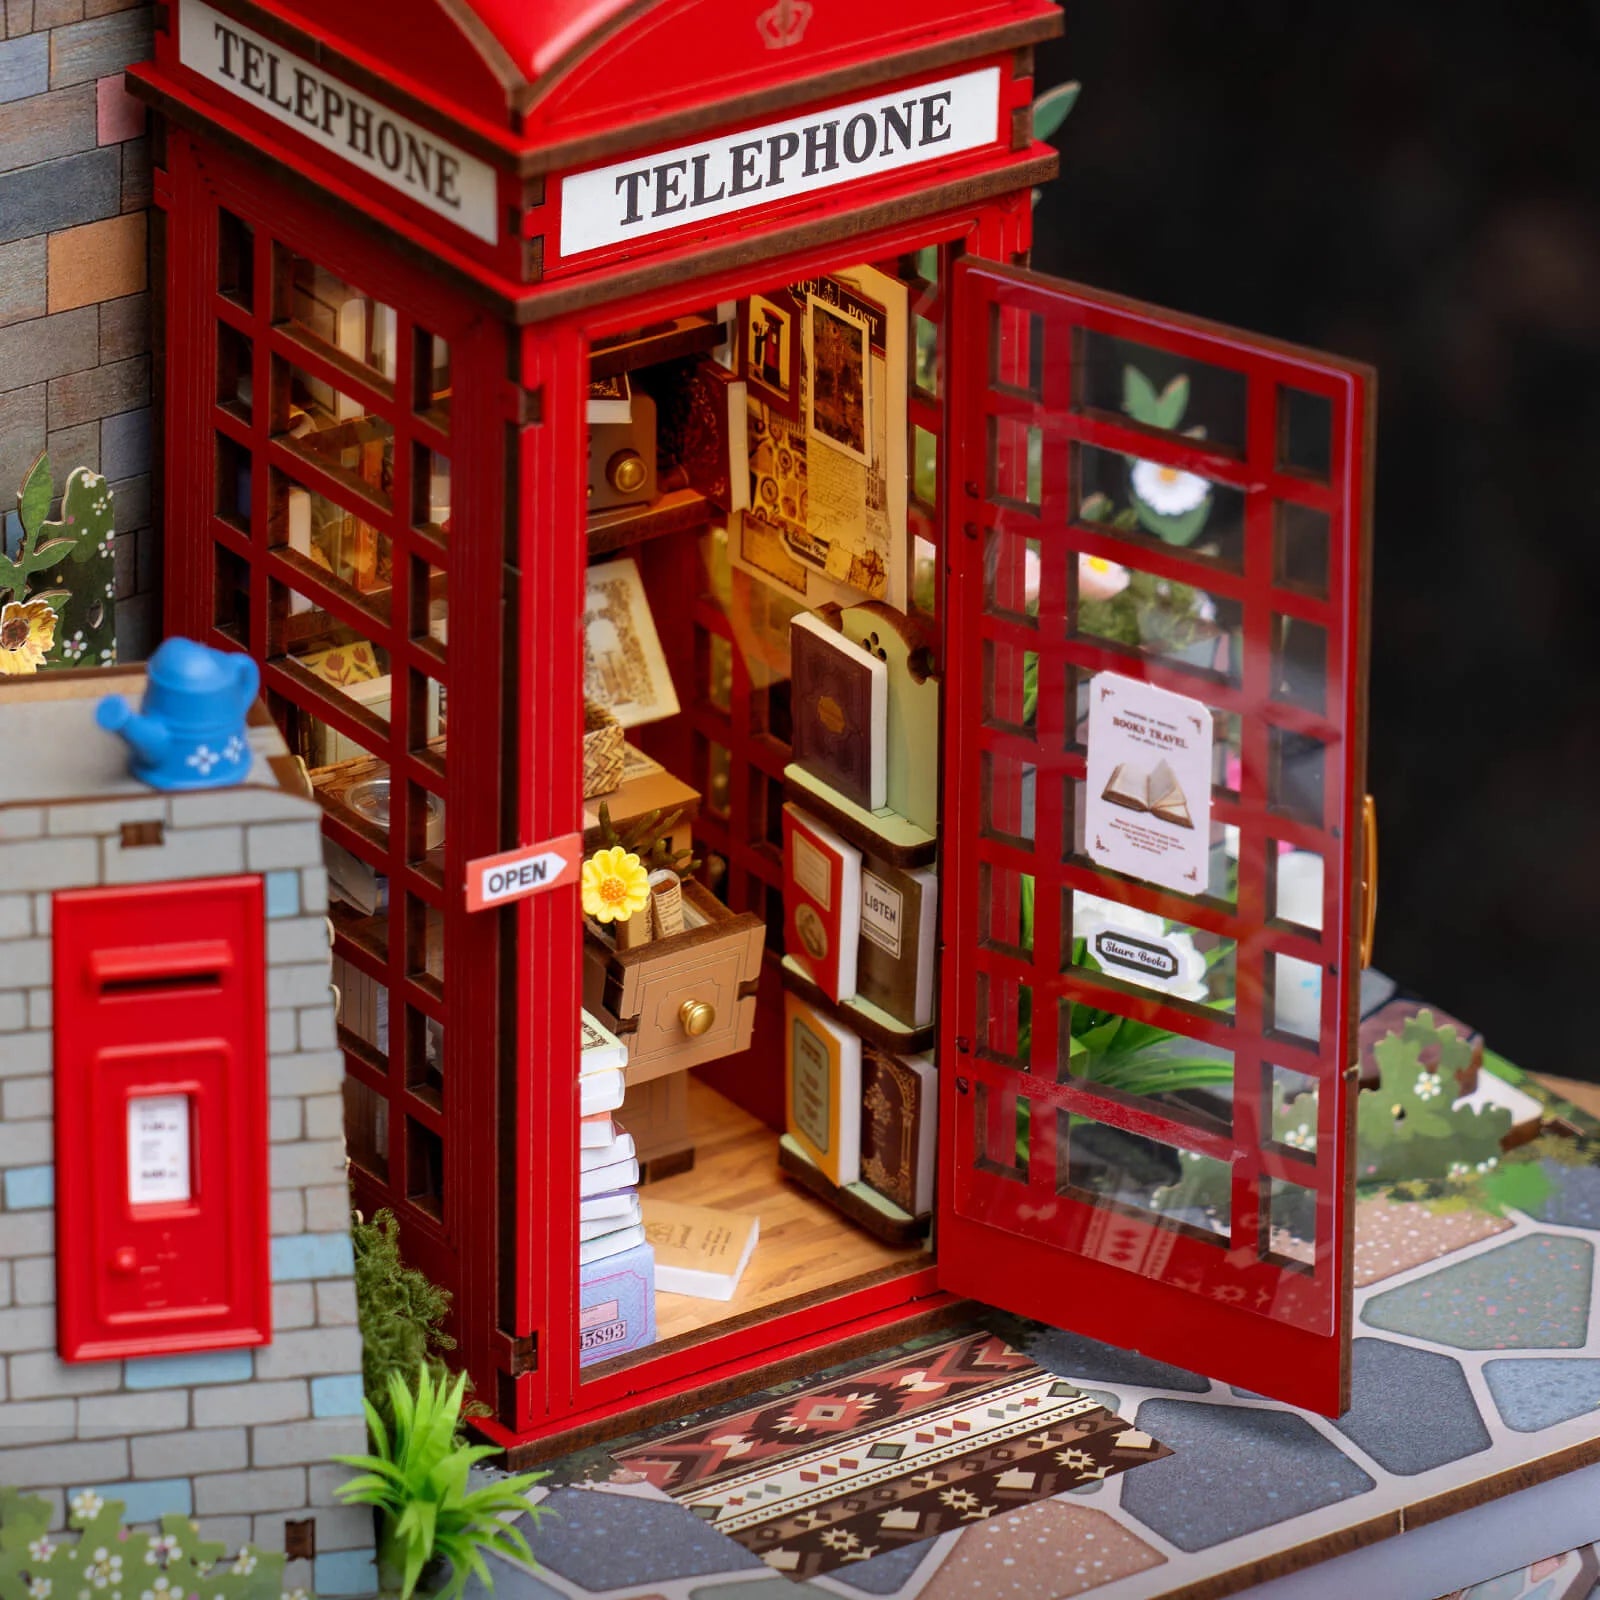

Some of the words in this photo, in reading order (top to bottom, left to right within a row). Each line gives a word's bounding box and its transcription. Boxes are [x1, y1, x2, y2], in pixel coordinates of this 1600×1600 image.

[215, 22, 461, 210] TELEPHONE
[615, 90, 952, 226] TELEPHONE
[847, 303, 878, 336] POST
[1113, 716, 1146, 735] BOOKS
[1149, 727, 1189, 749] TRAVEL
[488, 860, 547, 893] OPEN
[1105, 941, 1135, 959] Share
[1137, 951, 1167, 969] Books
